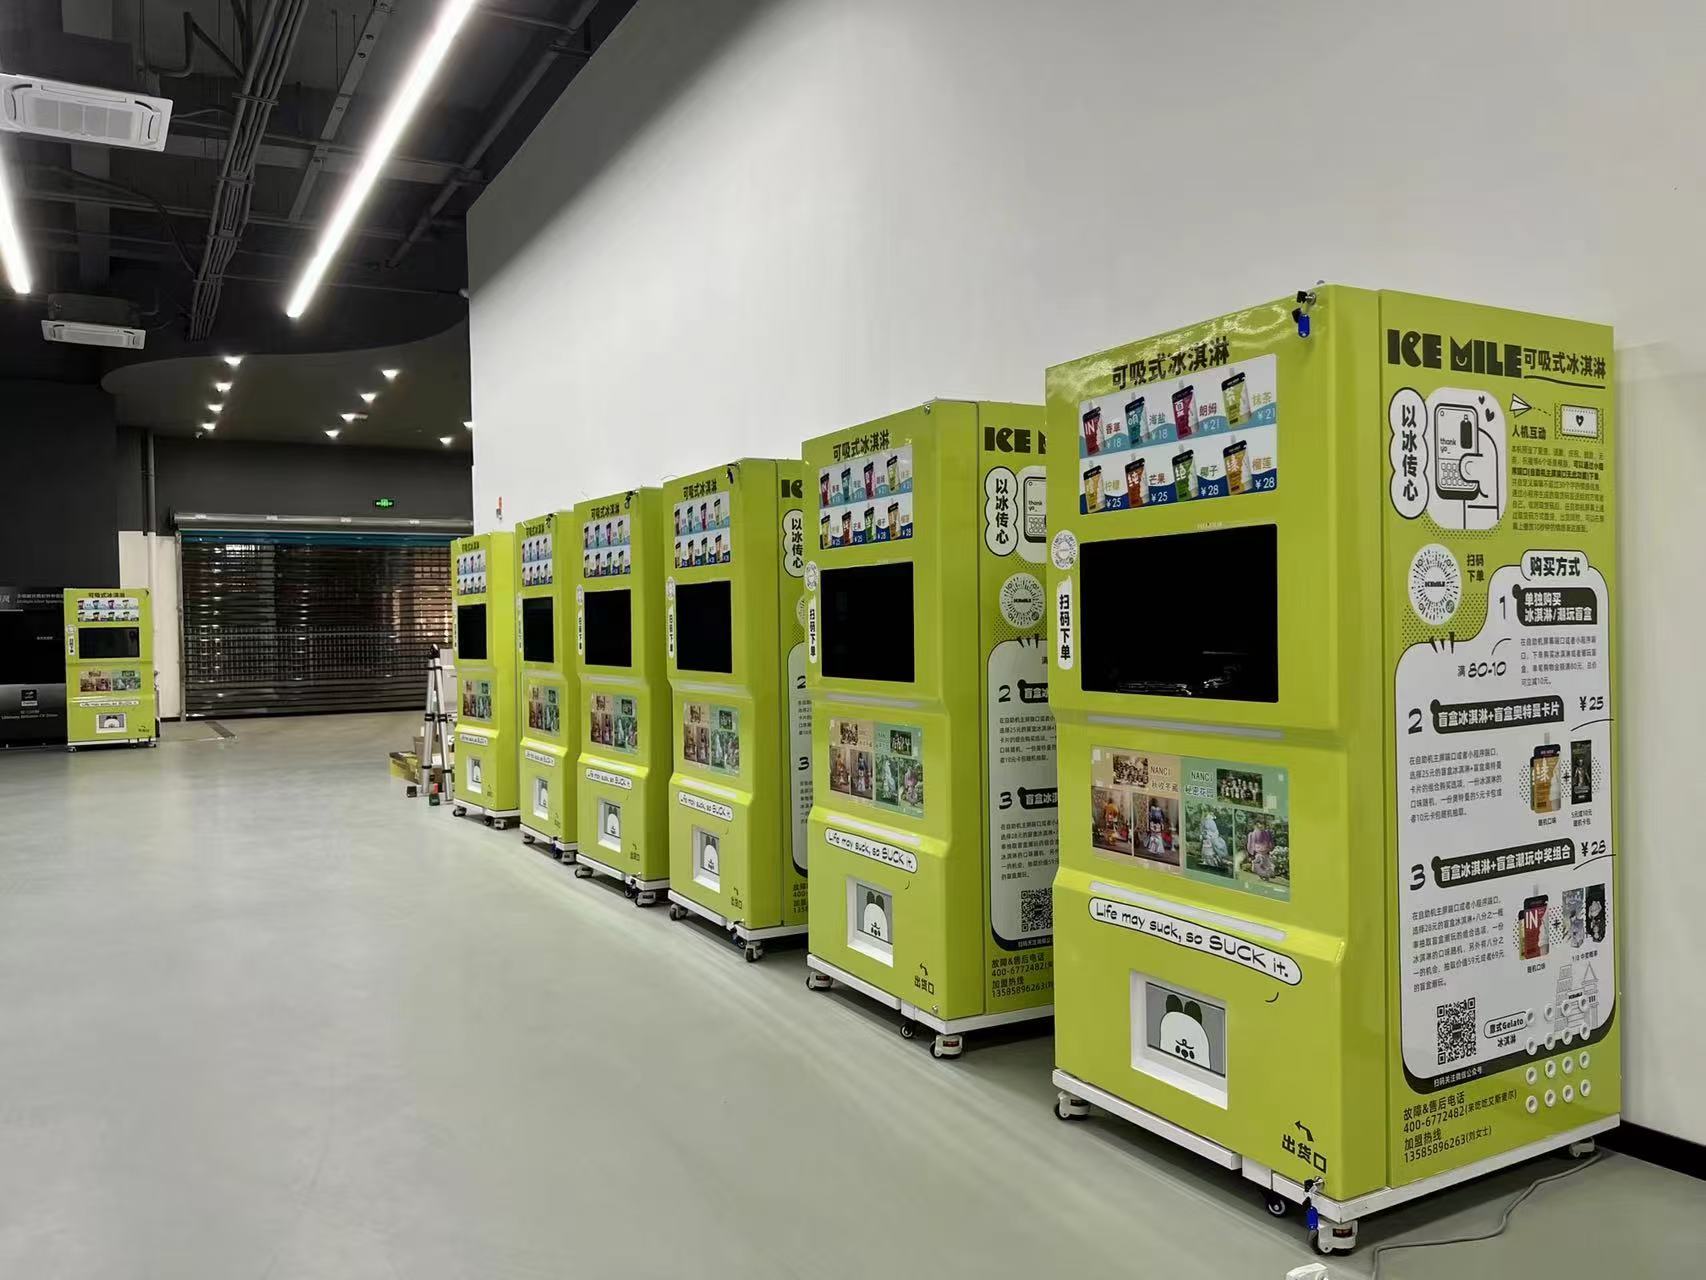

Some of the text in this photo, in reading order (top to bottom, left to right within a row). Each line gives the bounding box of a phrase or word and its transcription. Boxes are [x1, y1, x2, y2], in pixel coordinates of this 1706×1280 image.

[1112, 336, 1230, 390] 可吸式冰淇淋
[1387, 329, 1606, 379] ICE MILE 可吸式冰淇淋
[1199, 402, 1217, 417] 朗姆
[1256, 408, 1275, 420] ¥21
[1085, 420, 1096, 435] IN
[1202, 420, 1220, 430] ¥21
[1512, 424, 1546, 441] 人机互动
[832, 429, 890, 461] 可吸式冰淇淋
[984, 427, 1031, 454] ICE
[1440, 438, 1456, 446] thank
[1402, 405, 1418, 501] 以冰传心
[1149, 472, 1165, 485] 芒果
[1255, 477, 1275, 489] ¥28
[1151, 491, 1168, 502] ¥25
[1201, 484, 1219, 496] ¥28
[995, 478, 1009, 544] 以冰传心
[1106, 497, 1121, 508] ¥25
[791, 518, 804, 568] 以冰传心
[1467, 554, 1484, 567] 扫码
[1530, 556, 1580, 577] 购买方式
[1468, 569, 1484, 584] 下单
[1524, 592, 1561, 606] 单独购买
[1524, 606, 1592, 623] 冰淇淋/潮玩盲盒
[1060, 594, 1071, 660] 扫码下单
[797, 675, 806, 690] 2
[999, 684, 1011, 703] 2
[1579, 696, 1604, 711] ¥25
[1408, 708, 1423, 734] 2
[1438, 702, 1560, 728] 盲盒冰淇淋+盲盒奥特曼卡片
[798, 756, 810, 771] 3
[1151, 766, 1171, 776] NANCI
[1191, 771, 1213, 782] NANCI
[999, 791, 1012, 810] 3
[1581, 840, 1606, 857] ¥28
[1441, 845, 1571, 882] 盲盒冰淇淋+盲盒潮玩中奖组合
[1410, 864, 1426, 891] 3
[1525, 908, 1538, 930] IN
[1096, 902, 1289, 978] Life may suck, so SUCK it.
[914, 975, 935, 995] 出货口
[1497, 1034, 1516, 1047] 冰淇淋
[1433, 1066, 1483, 1088] 扫码关注微信公众号
[1403, 1091, 1465, 1121] 故障&售后电话
[1404, 1128, 1442, 1151] 加盟热线
[1282, 1134, 1327, 1174] 出货口
